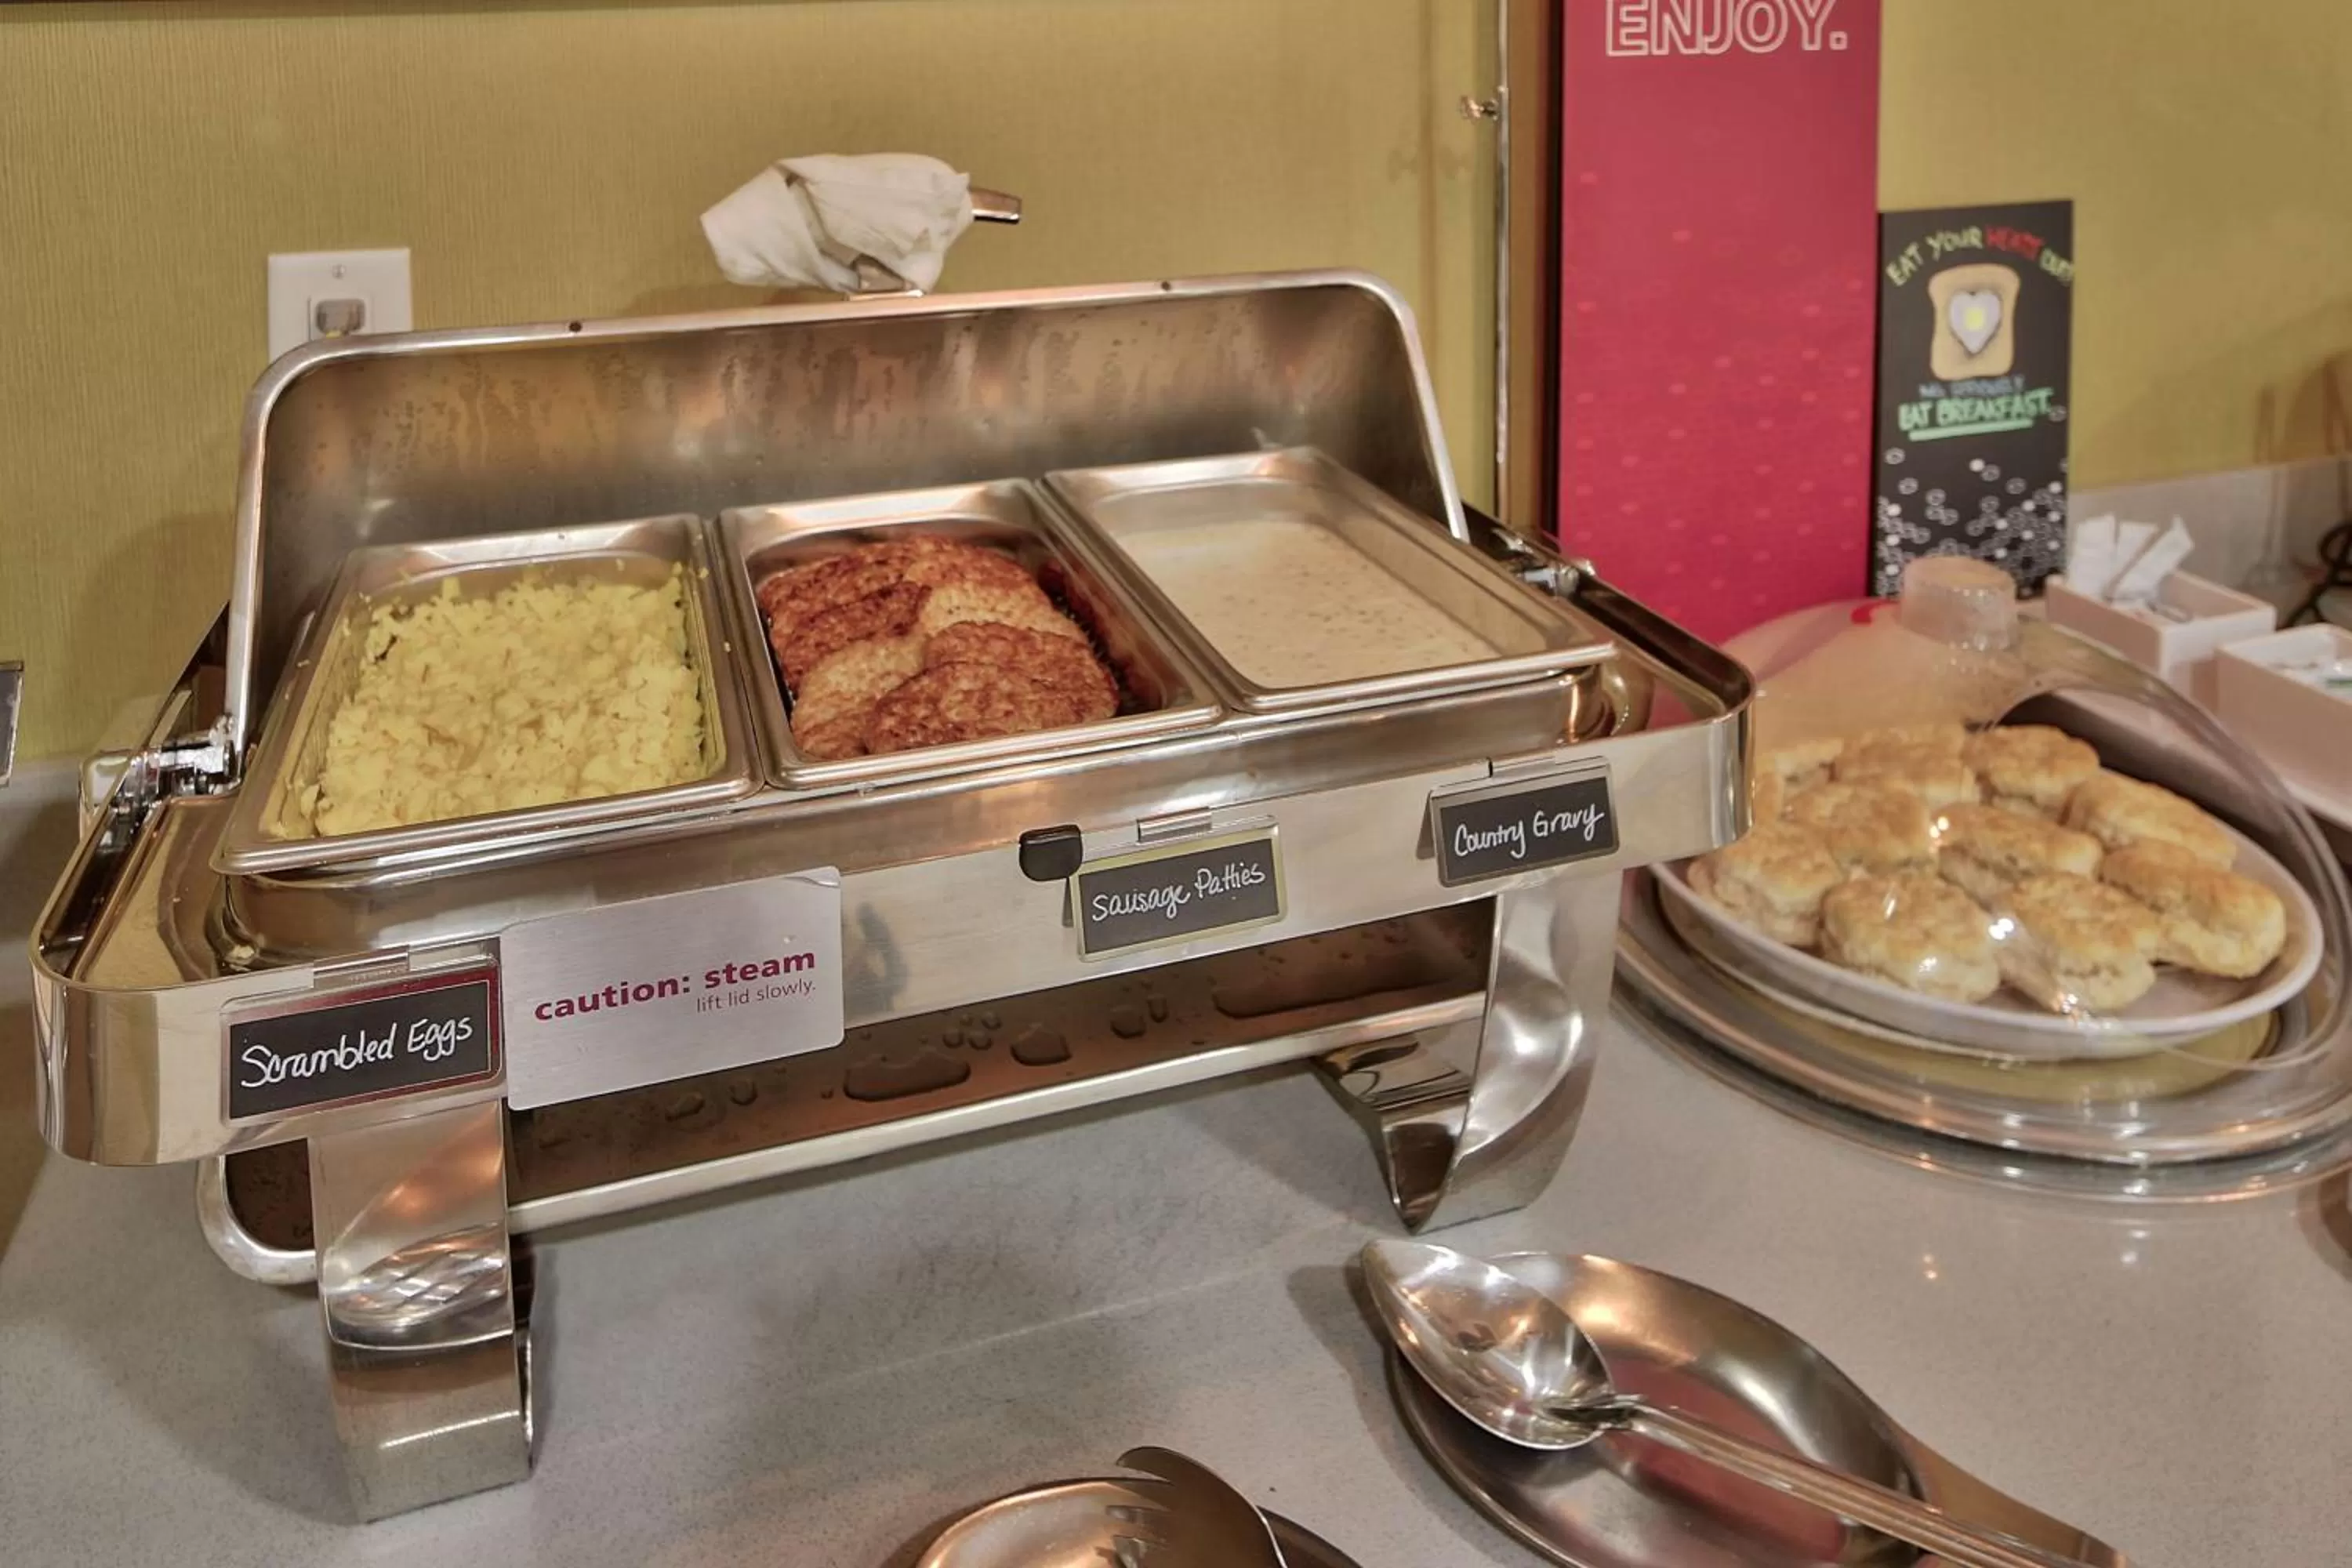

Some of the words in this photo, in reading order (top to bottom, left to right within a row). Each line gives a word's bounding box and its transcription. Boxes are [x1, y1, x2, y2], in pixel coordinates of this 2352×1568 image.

[1606, 0, 1848, 56] ENJOY.
[1886, 241, 1924, 286] EAT
[1926, 226, 1983, 260] YOUR
[1898, 402, 1933, 430] EAT
[1454, 820, 1526, 858] Country
[1533, 803, 1605, 841] Gravy
[1092, 884, 1191, 919] Sausage
[1194, 862, 1265, 898] Patties
[534, 975, 691, 1021] caution:
[705, 952, 815, 989] steam
[697, 997, 722, 1014] lift
[728, 989, 750, 1008] lid
[757, 978, 816, 1001] slowly.
[241, 1022, 397, 1087] Scrambled
[407, 1017, 473, 1061] Eggs
